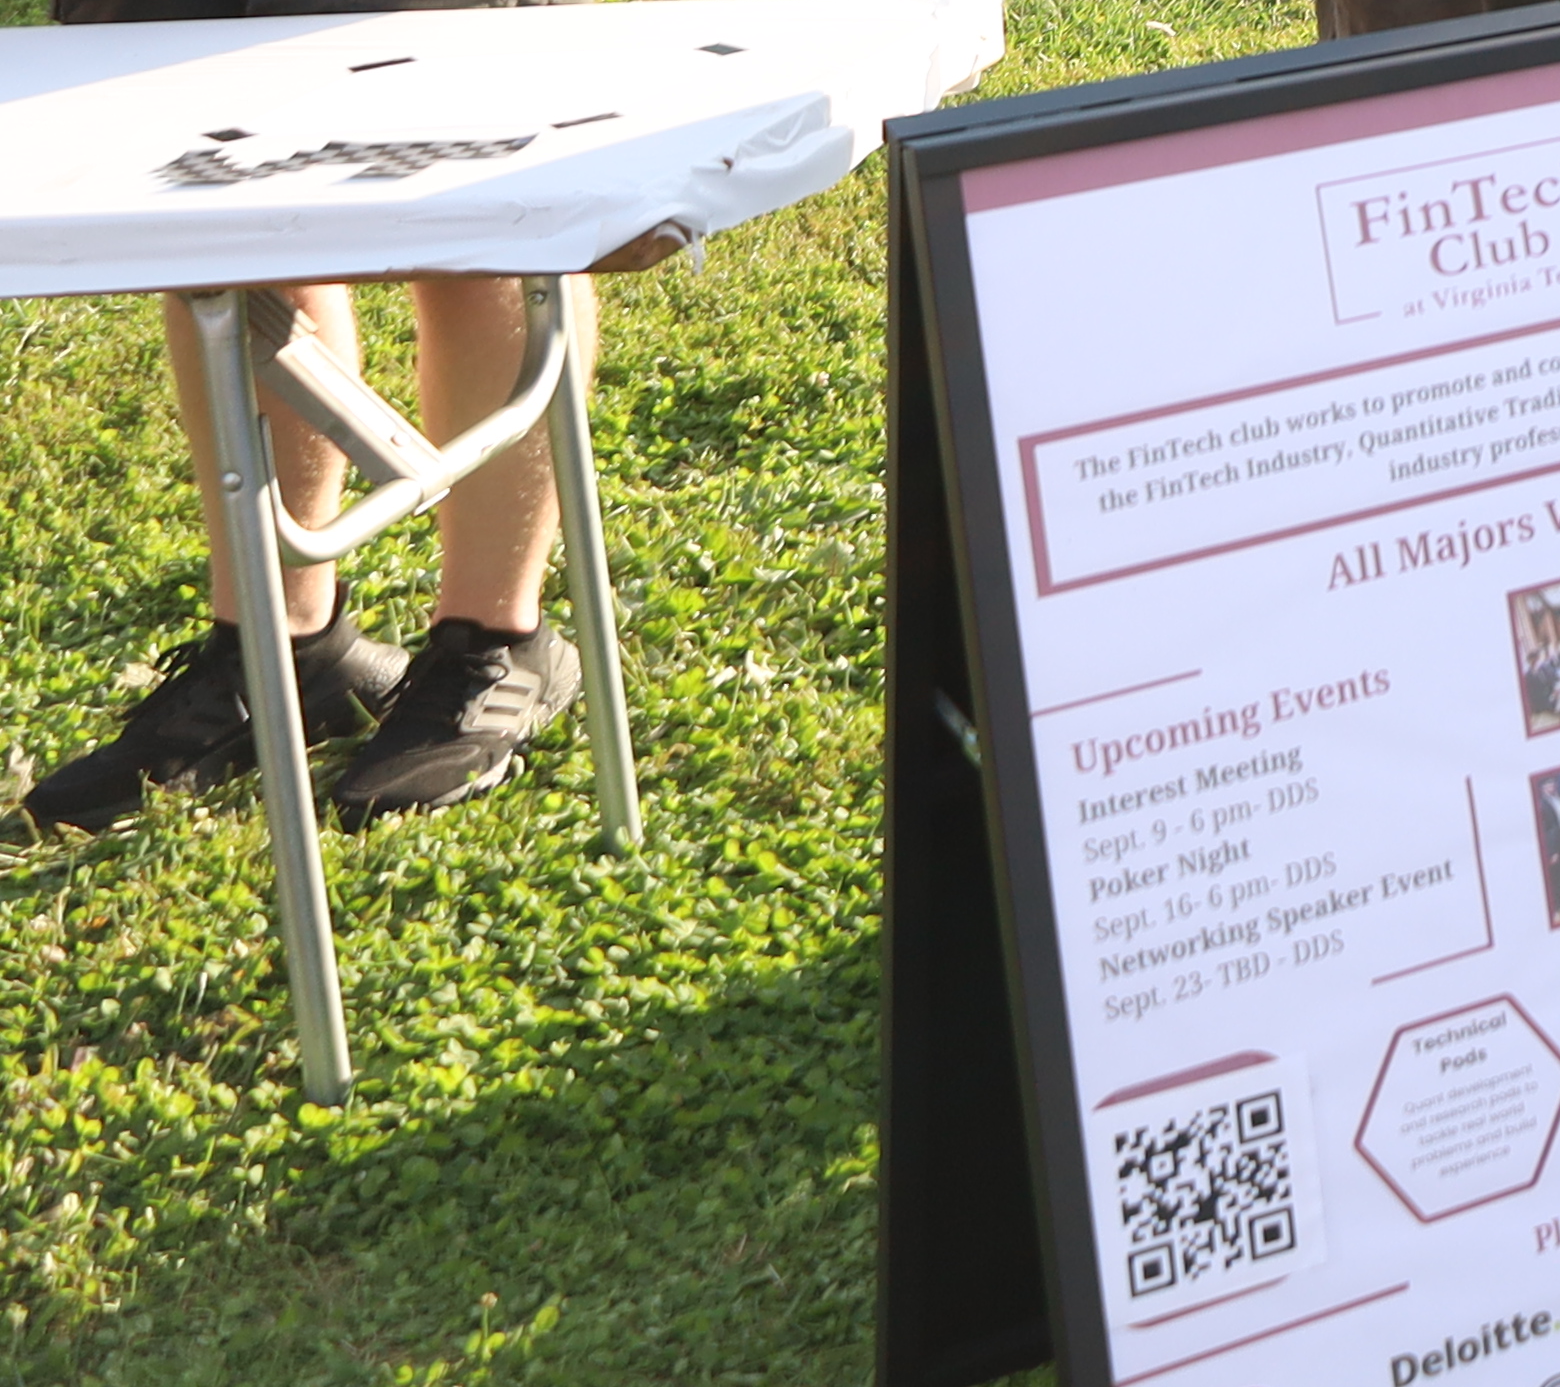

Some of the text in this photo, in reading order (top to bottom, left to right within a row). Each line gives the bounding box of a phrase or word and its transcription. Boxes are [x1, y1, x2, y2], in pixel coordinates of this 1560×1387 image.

[1429, 219, 1549, 275] Club
[1403, 298, 1424, 318] at
[1431, 273, 1532, 310] Virginia
[1073, 455, 1120, 481] The
[1127, 429, 1223, 469] FinTech
[1229, 415, 1280, 446] club
[1285, 400, 1357, 433] works
[1361, 396, 1385, 416] to
[1390, 373, 1486, 416] promote
[1491, 357, 1532, 387] and
[1098, 488, 1138, 513] the
[1144, 462, 1240, 503] FinTech
[1245, 440, 1352, 479] Industry,
[1357, 405, 1499, 457] Quantitative
[1389, 444, 1483, 482] industry
[1328, 541, 1384, 590] All
[1396, 514, 1535, 572] Majors
[1071, 669, 1390, 777] Upcoming Events
[1078, 746, 1303, 824] Interest Meeting
[1082, 829, 1145, 864] Sept.
[1150, 819, 1167, 845] 9
[1189, 808, 1204, 833] 6
[1211, 800, 1260, 836] pm-
[1266, 776, 1319, 815] DDS
[1089, 838, 1250, 904] Poker Night
[1093, 851, 1336, 942] Sept. 16- 6 pm- DDS
[1099, 859, 1453, 982] Networking Speaker Event
[1103, 986, 1166, 1021] Sept.
[1173, 970, 1211, 1003] 23-
[1216, 951, 1270, 988] TBD
[1292, 928, 1344, 967] DDS
